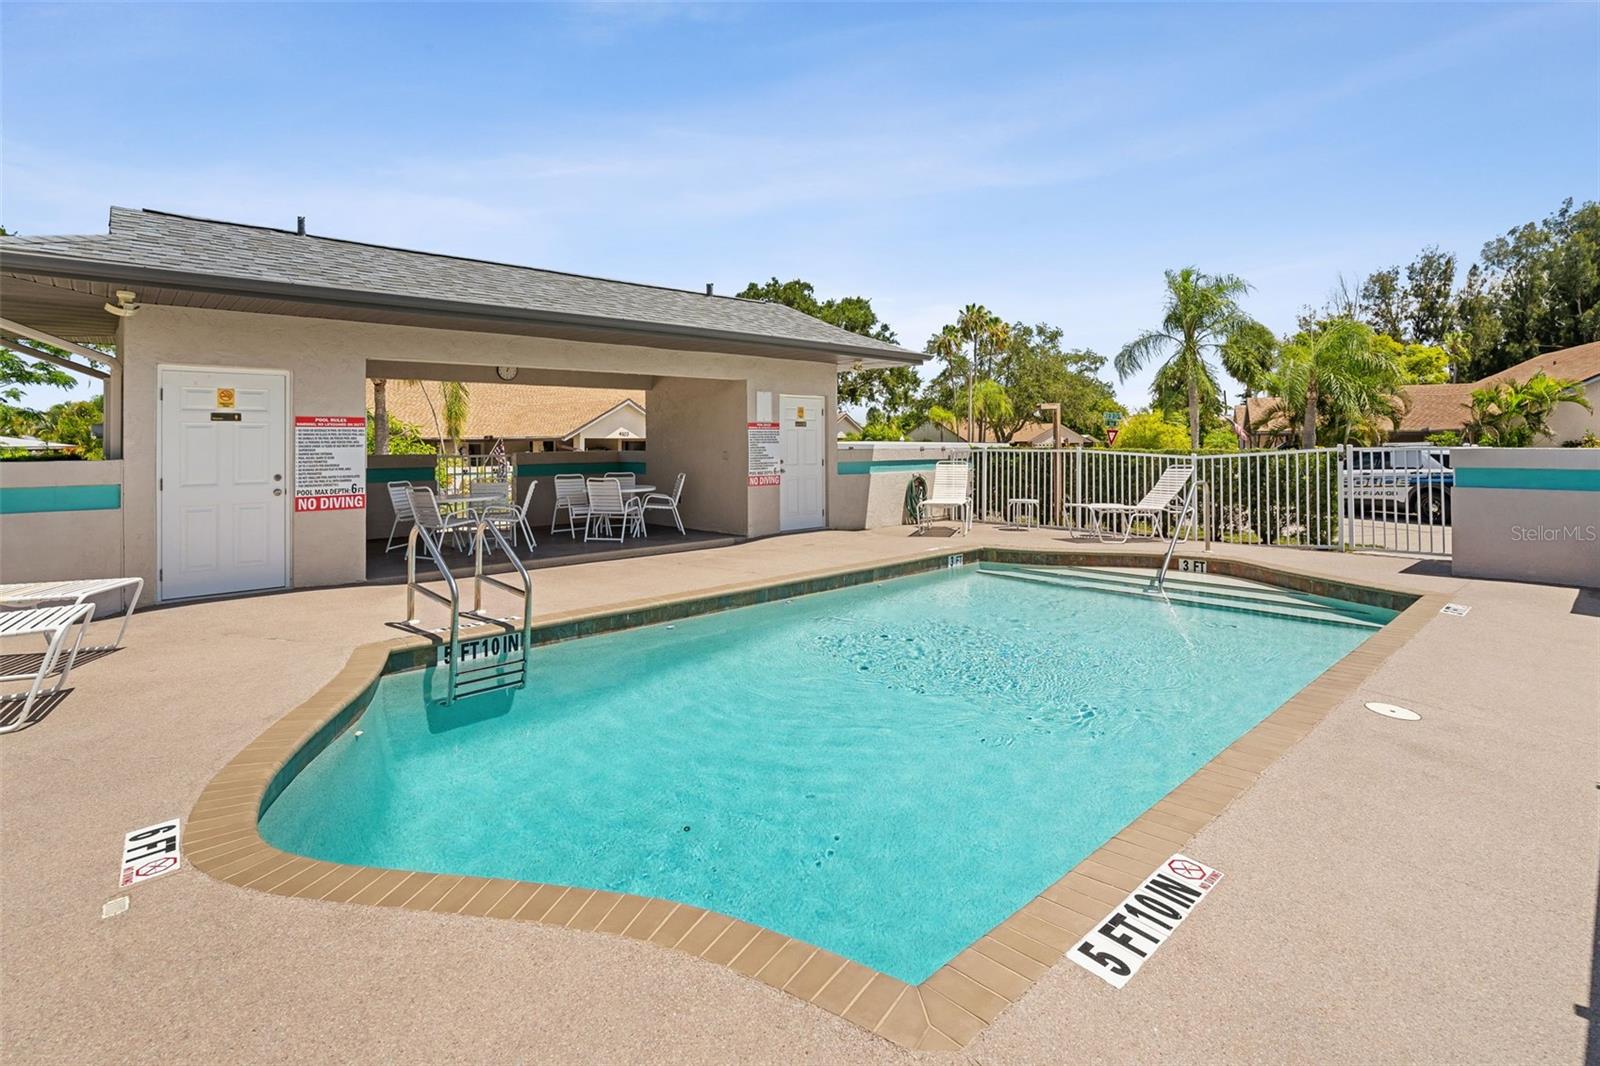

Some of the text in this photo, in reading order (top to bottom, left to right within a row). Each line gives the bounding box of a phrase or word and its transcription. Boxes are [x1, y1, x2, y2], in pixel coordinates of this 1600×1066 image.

[351, 483, 358, 494] 6
[298, 496, 364, 510] NO DIVING
[1183, 560, 1206, 573] 3 FT
[461, 641, 479, 661] FT
[503, 634, 519, 653] IN
[125, 825, 176, 863] 6 FT
[1077, 941, 1131, 976] 5
